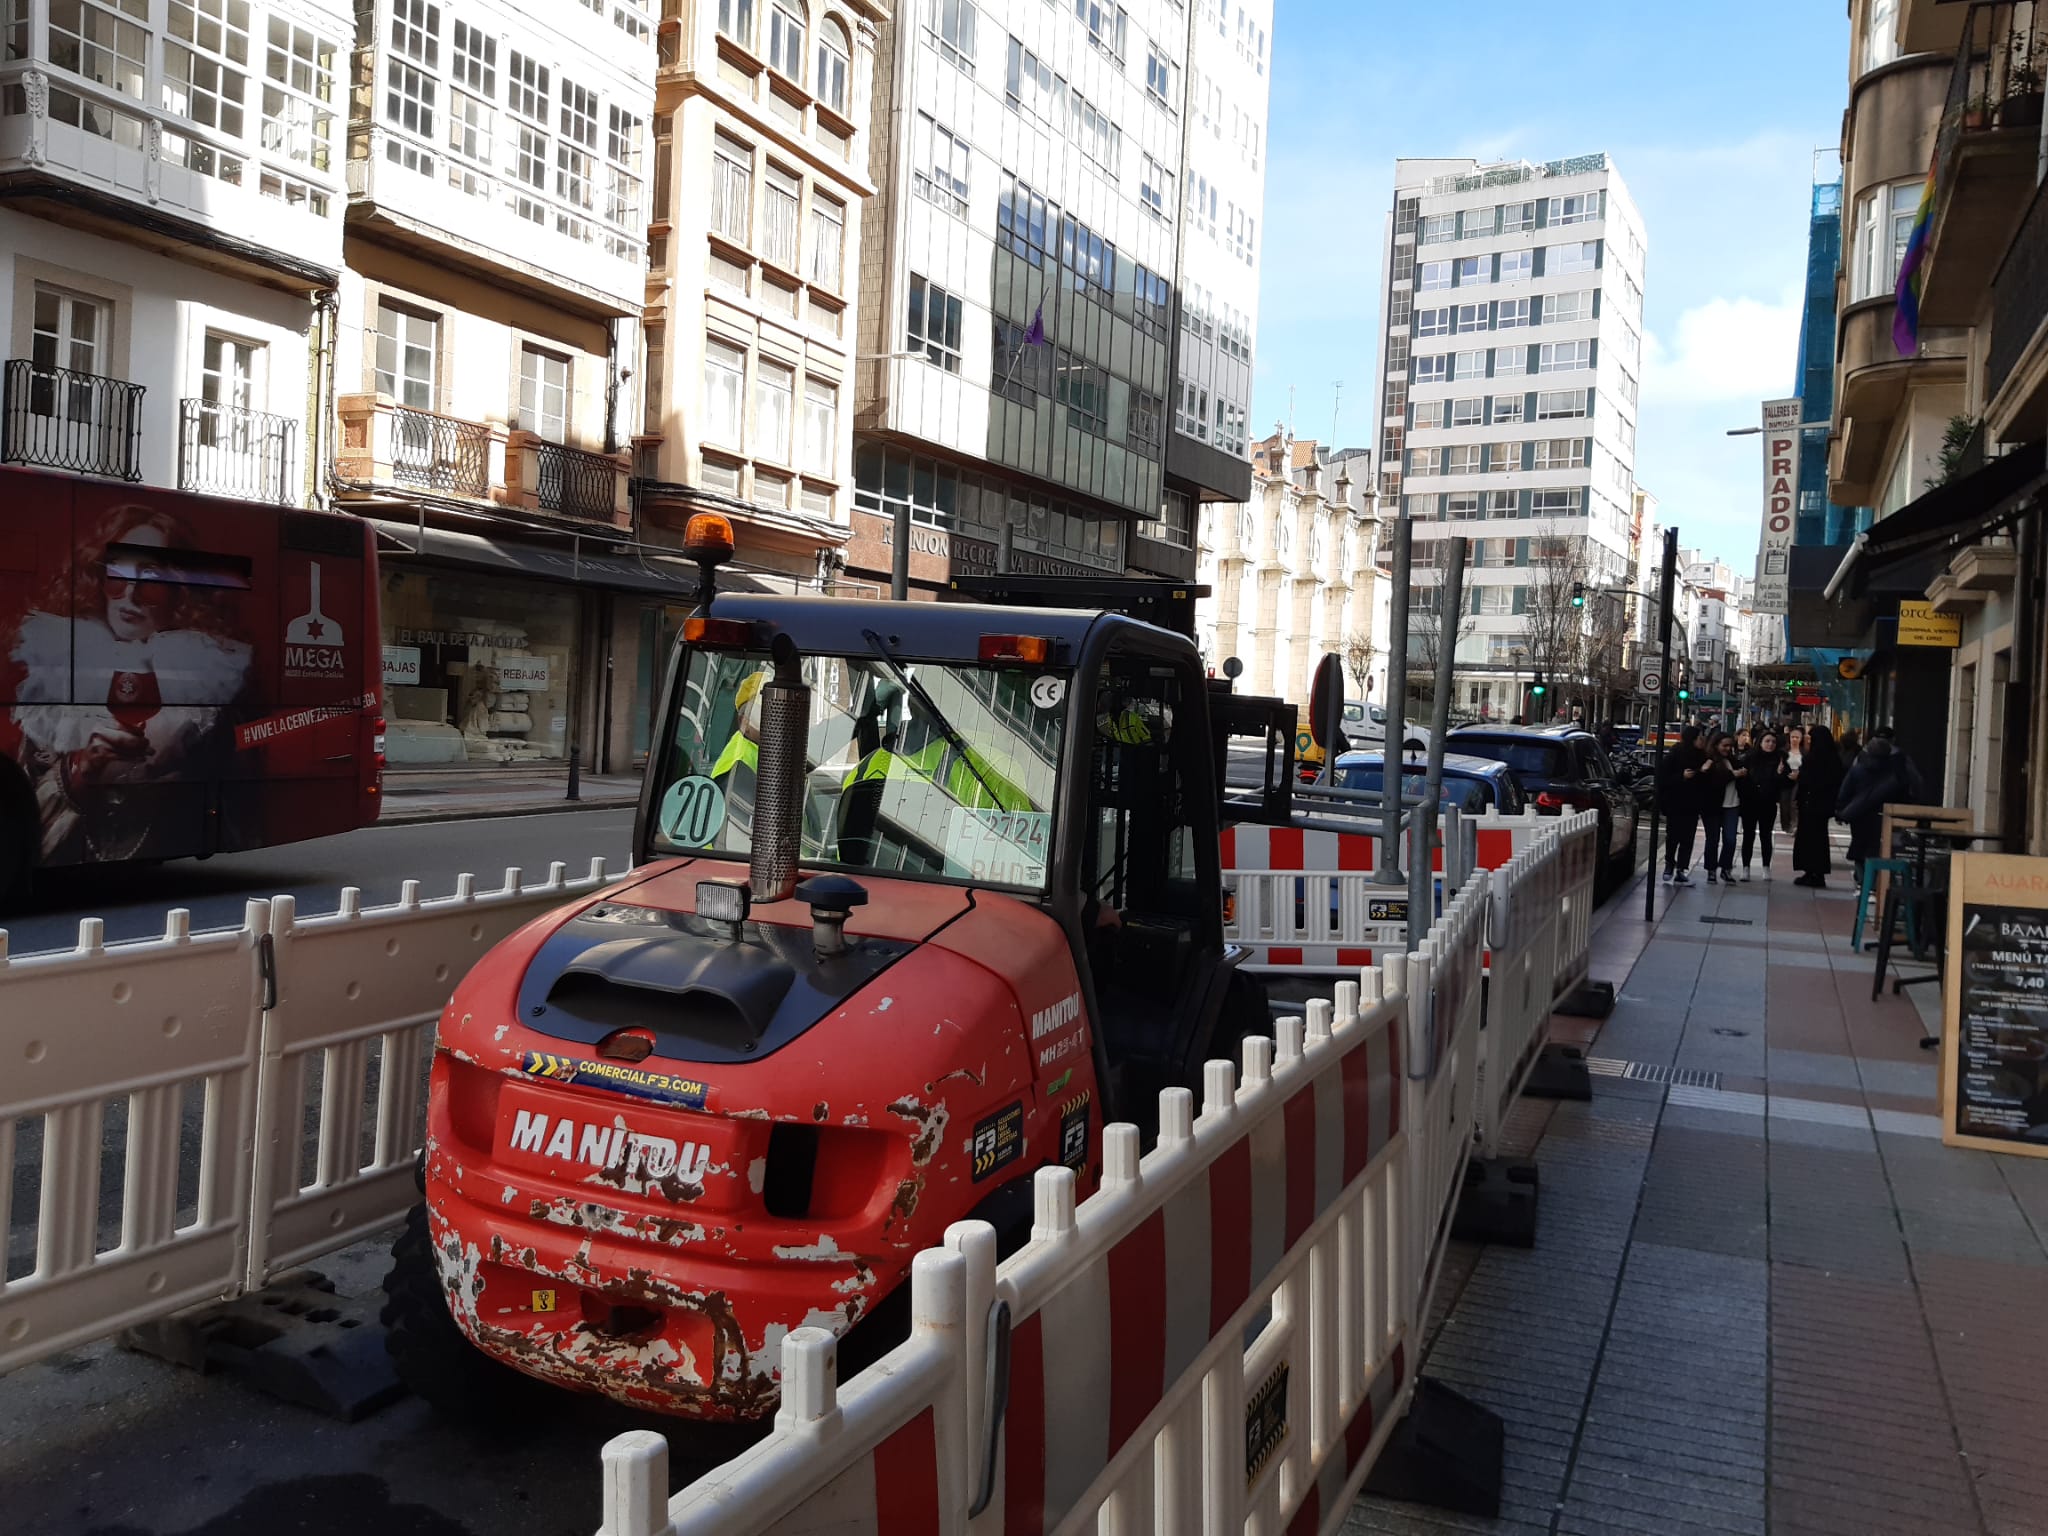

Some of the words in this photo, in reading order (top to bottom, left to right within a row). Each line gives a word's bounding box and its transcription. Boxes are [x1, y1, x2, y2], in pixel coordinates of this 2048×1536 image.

[1765, 405, 1790, 418] TALLERES
[1791, 404, 1799, 416] DE
[1769, 439, 1793, 533] PRADO
[882, 523, 949, 558] RNION
[953, 540, 1024, 573] RECREAVA
[401, 629, 415, 643] EL
[285, 647, 345, 669] MEGA
[382, 660, 416, 674] BAJAS
[503, 668, 546, 681] REBAJAS
[1034, 683, 1057, 701] CE
[243, 721, 274, 743] #VIVE
[274, 719, 288, 735] LA
[287, 706, 329, 731] CERVEZA
[670, 781, 715, 842] 20
[960, 814, 976, 839] E
[983, 816, 1043, 845] 2724
[1984, 871, 2048, 891] AUAR
[2015, 975, 2045, 989] 7,40
[1033, 991, 1079, 1040] MANITOU
[579, 1060, 702, 1095] COMERCIALF3.COM
[510, 1109, 711, 1184] MANITOU
[976, 1128, 996, 1158] F3
[1064, 1121, 1085, 1154] F3
